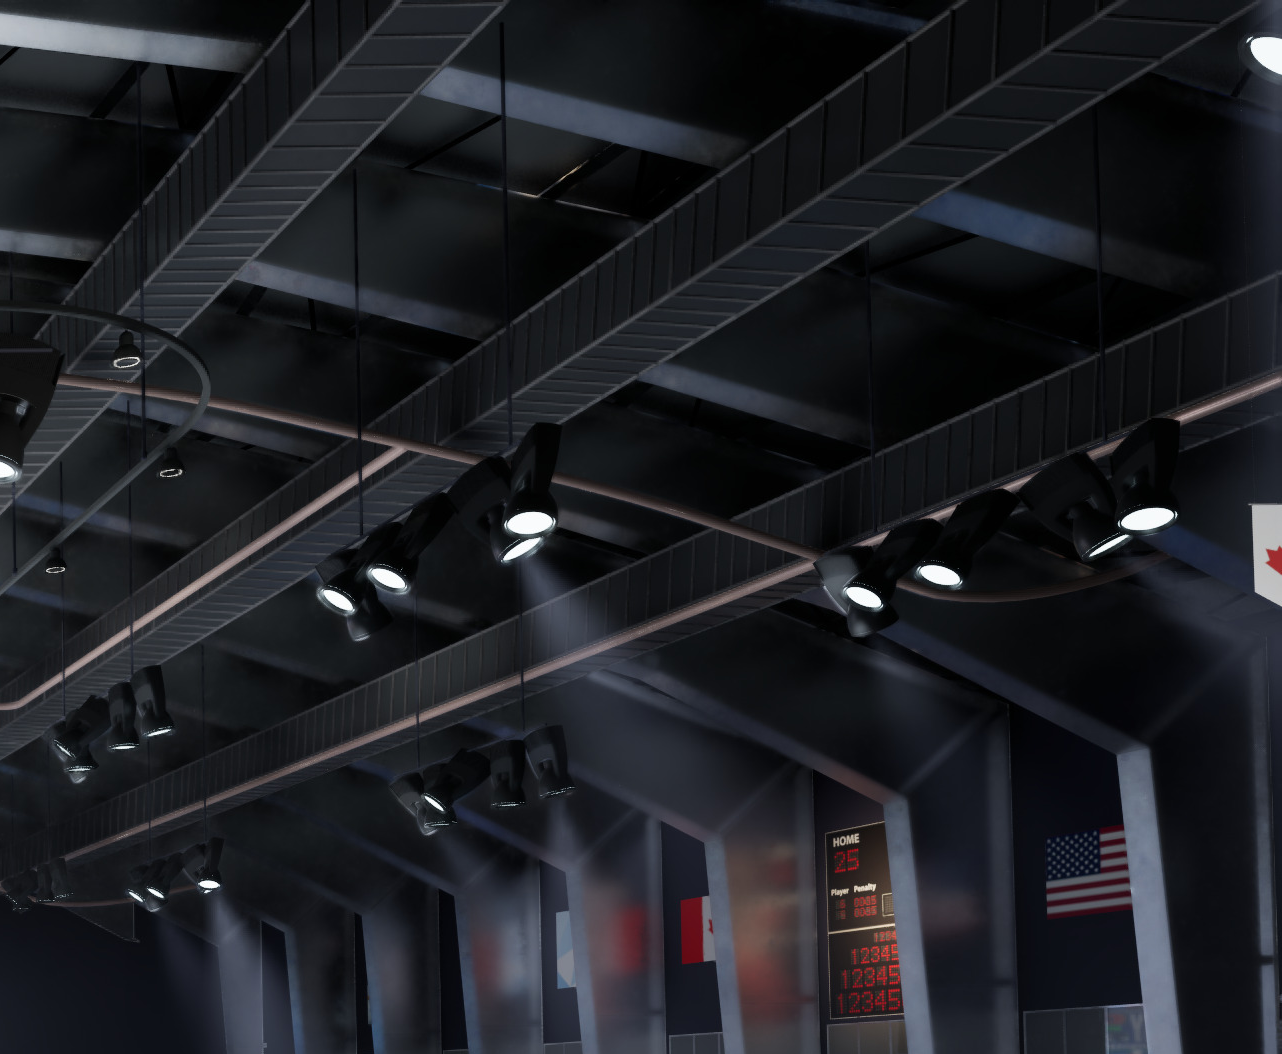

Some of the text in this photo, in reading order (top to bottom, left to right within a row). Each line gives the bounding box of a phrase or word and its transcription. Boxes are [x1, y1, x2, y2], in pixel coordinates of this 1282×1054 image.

[832, 833, 860, 848] HOME
[834, 848, 859, 873] 25
[830, 882, 877, 897] Player Penalty
